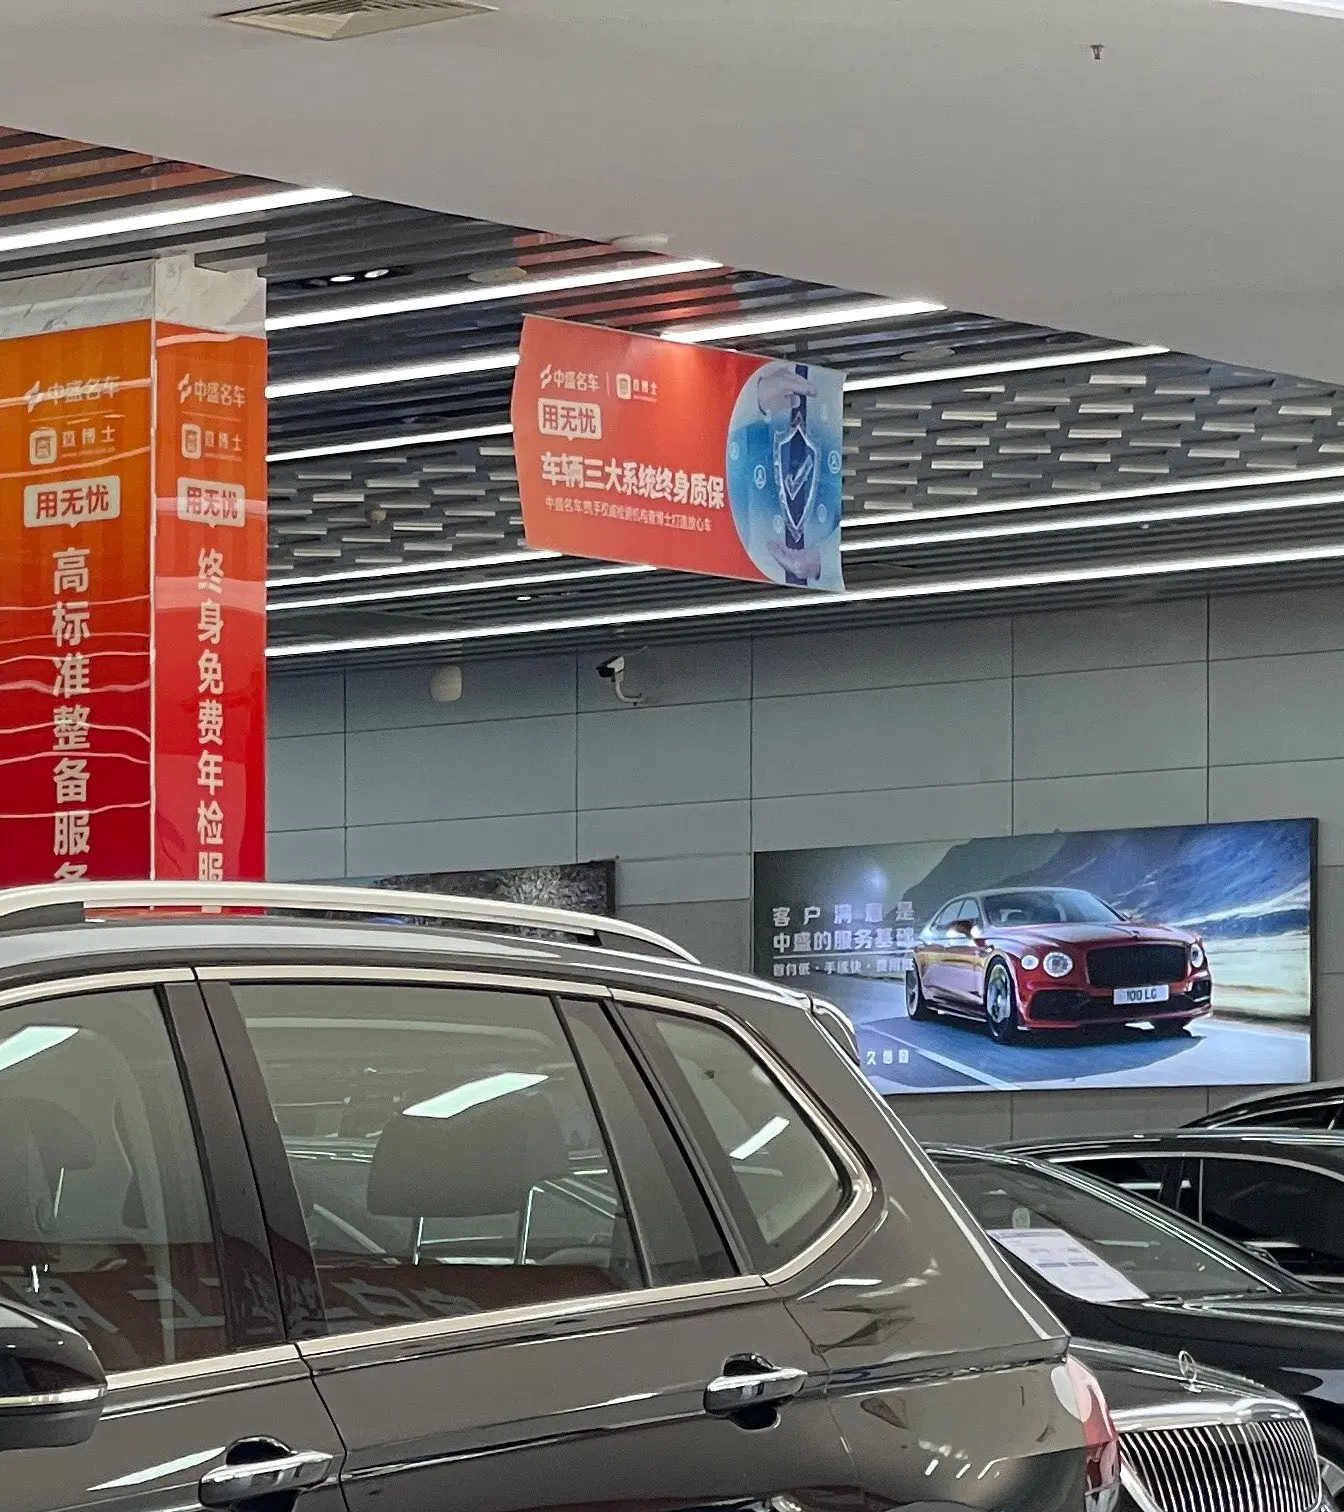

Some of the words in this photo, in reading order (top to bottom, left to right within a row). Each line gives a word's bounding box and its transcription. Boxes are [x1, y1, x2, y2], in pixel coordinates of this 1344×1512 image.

[194, 379, 246, 408] 中盛名车
[553, 370, 600, 391] 中盛名车
[542, 405, 597, 434] 用无忧
[540, 451, 725, 510] 车辆三大系统终身质保
[36, 485, 109, 519] 用无忧
[187, 486, 238, 520] 用无忧
